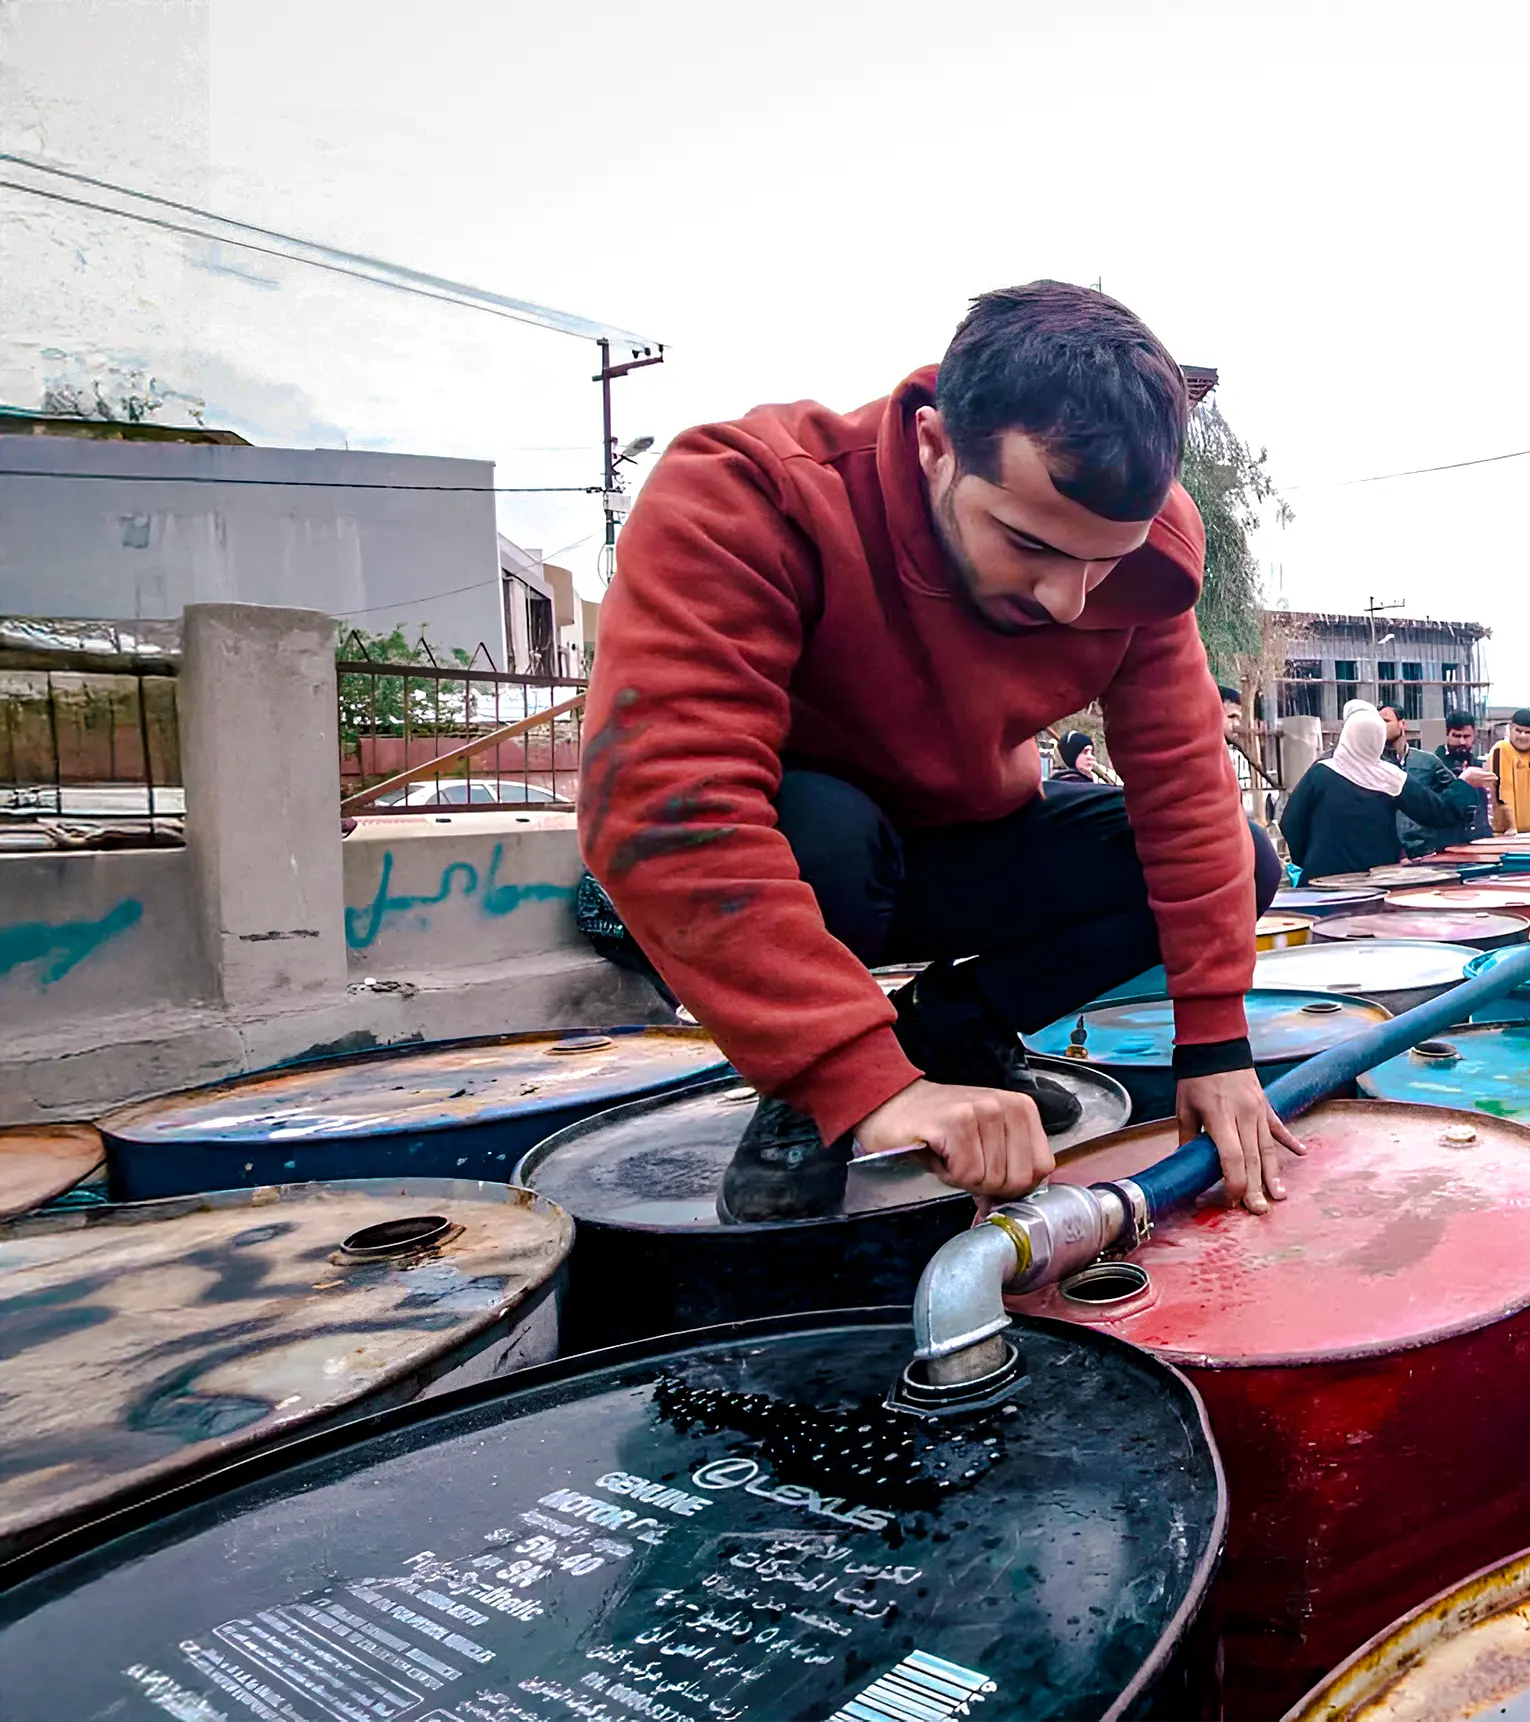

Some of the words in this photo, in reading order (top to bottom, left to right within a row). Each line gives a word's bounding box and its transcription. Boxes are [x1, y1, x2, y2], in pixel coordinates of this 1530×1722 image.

[537, 1488, 638, 1531] MOTOR
[595, 1471, 714, 1517] GENUINE
[745, 1475, 896, 1531] LEXUS
